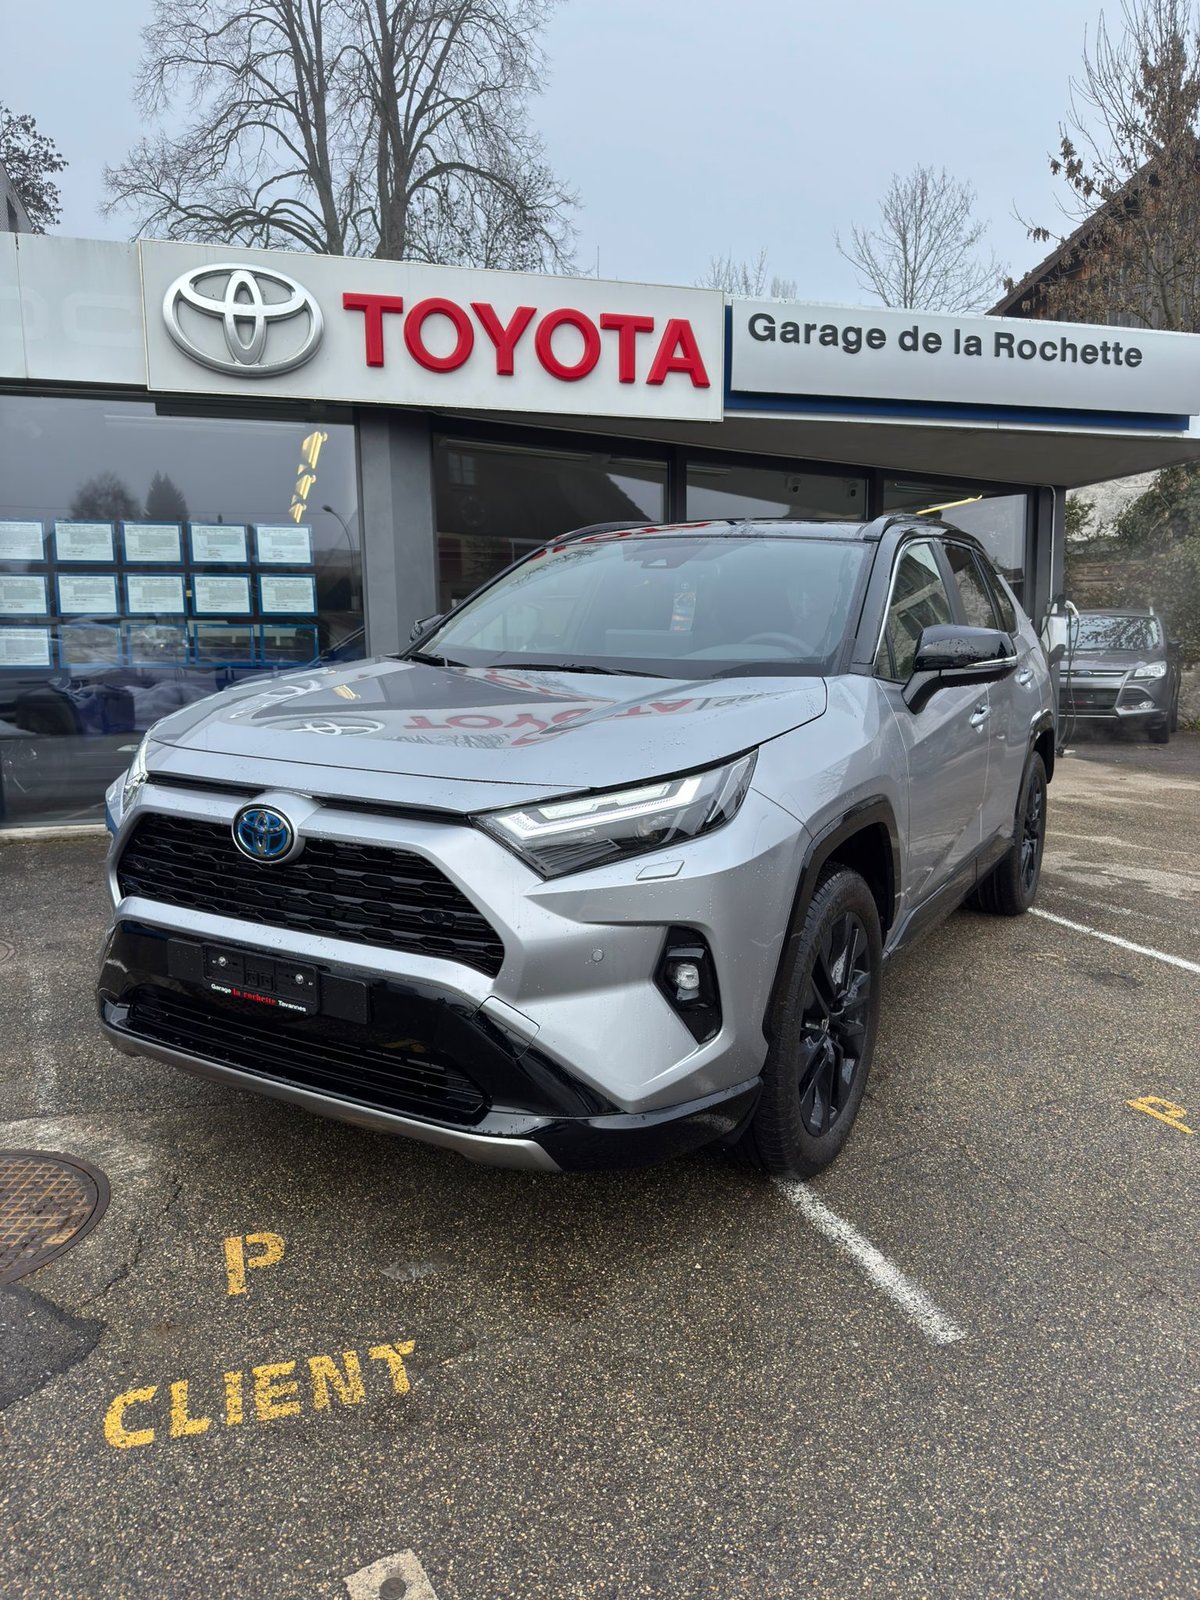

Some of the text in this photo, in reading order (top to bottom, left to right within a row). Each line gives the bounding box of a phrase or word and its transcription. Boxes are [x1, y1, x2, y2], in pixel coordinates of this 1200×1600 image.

[343, 293, 710, 389] TOYOTA
[747, 311, 1144, 369] Garage de la Rochette
[210, 983, 232, 995] Garage
[277, 999, 307, 1013] Tavannes
[1126, 1095, 1193, 1134] P
[223, 1231, 285, 1296] P
[103, 1340, 416, 1449] CLIENT
